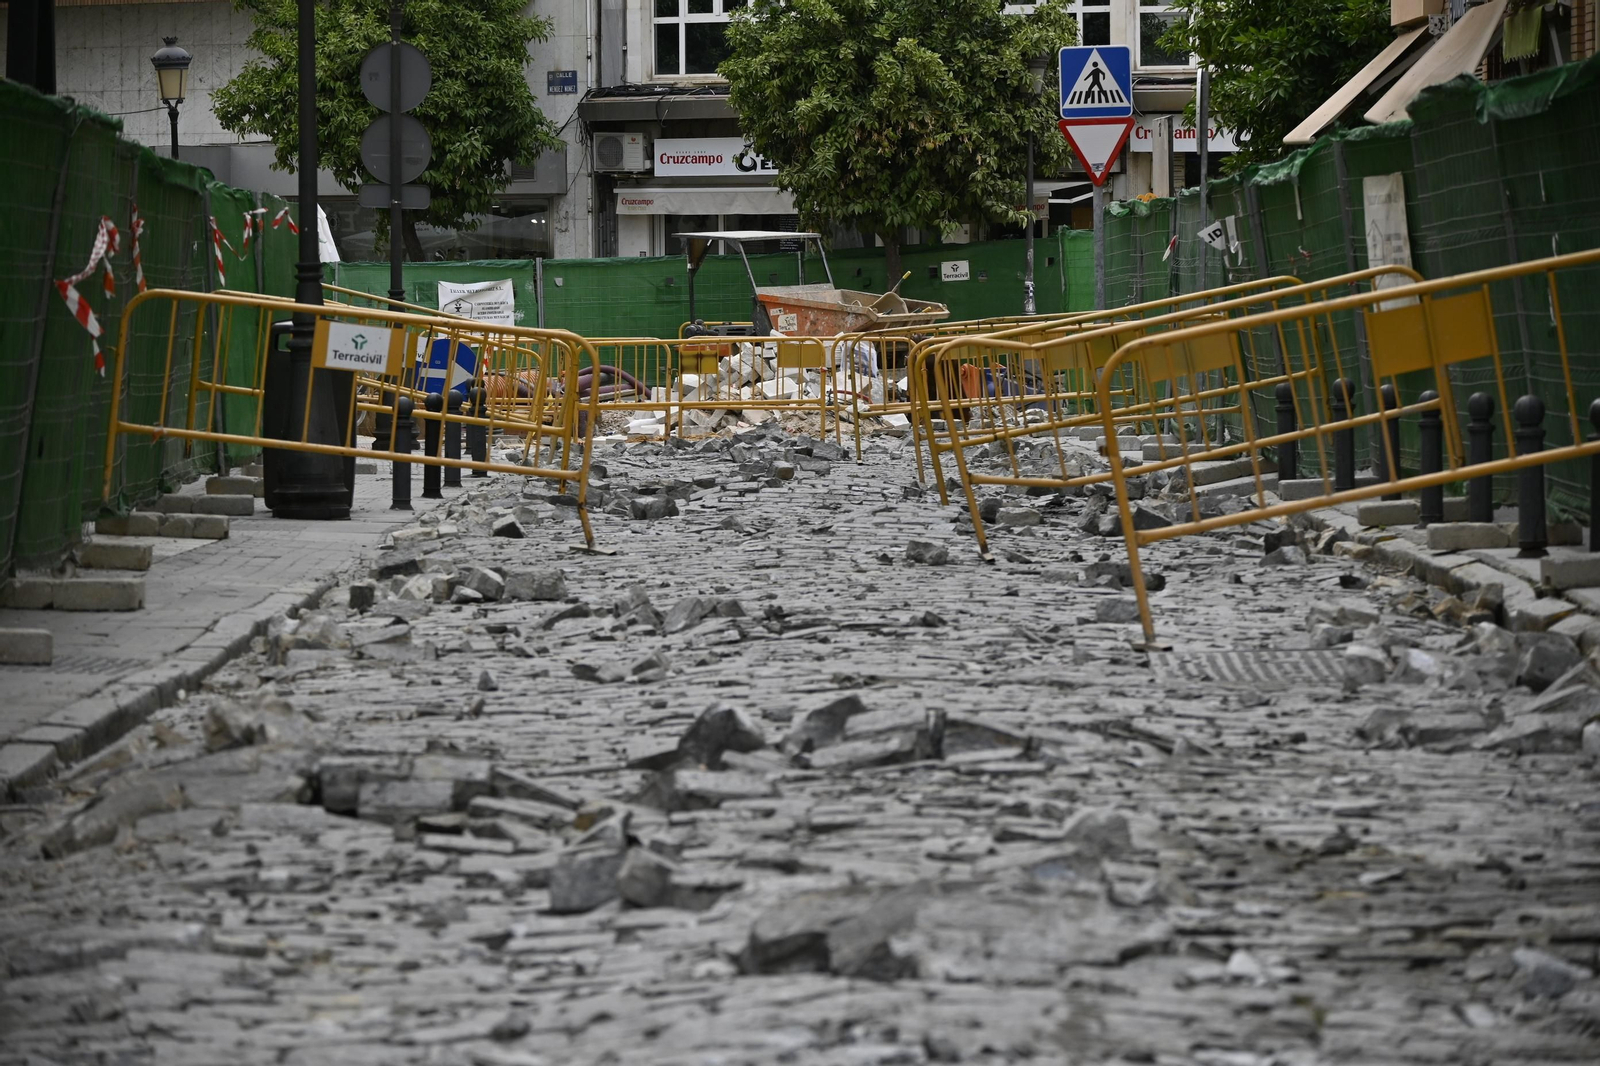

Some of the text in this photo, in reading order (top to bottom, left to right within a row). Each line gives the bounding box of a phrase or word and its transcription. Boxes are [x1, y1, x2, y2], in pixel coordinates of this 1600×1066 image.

[659, 152, 723, 166] Cruzcampo
[621, 197, 654, 206] Cruzcampo
[943, 271, 968, 279] Terracivil
[332, 349, 382, 365] Terracivil
